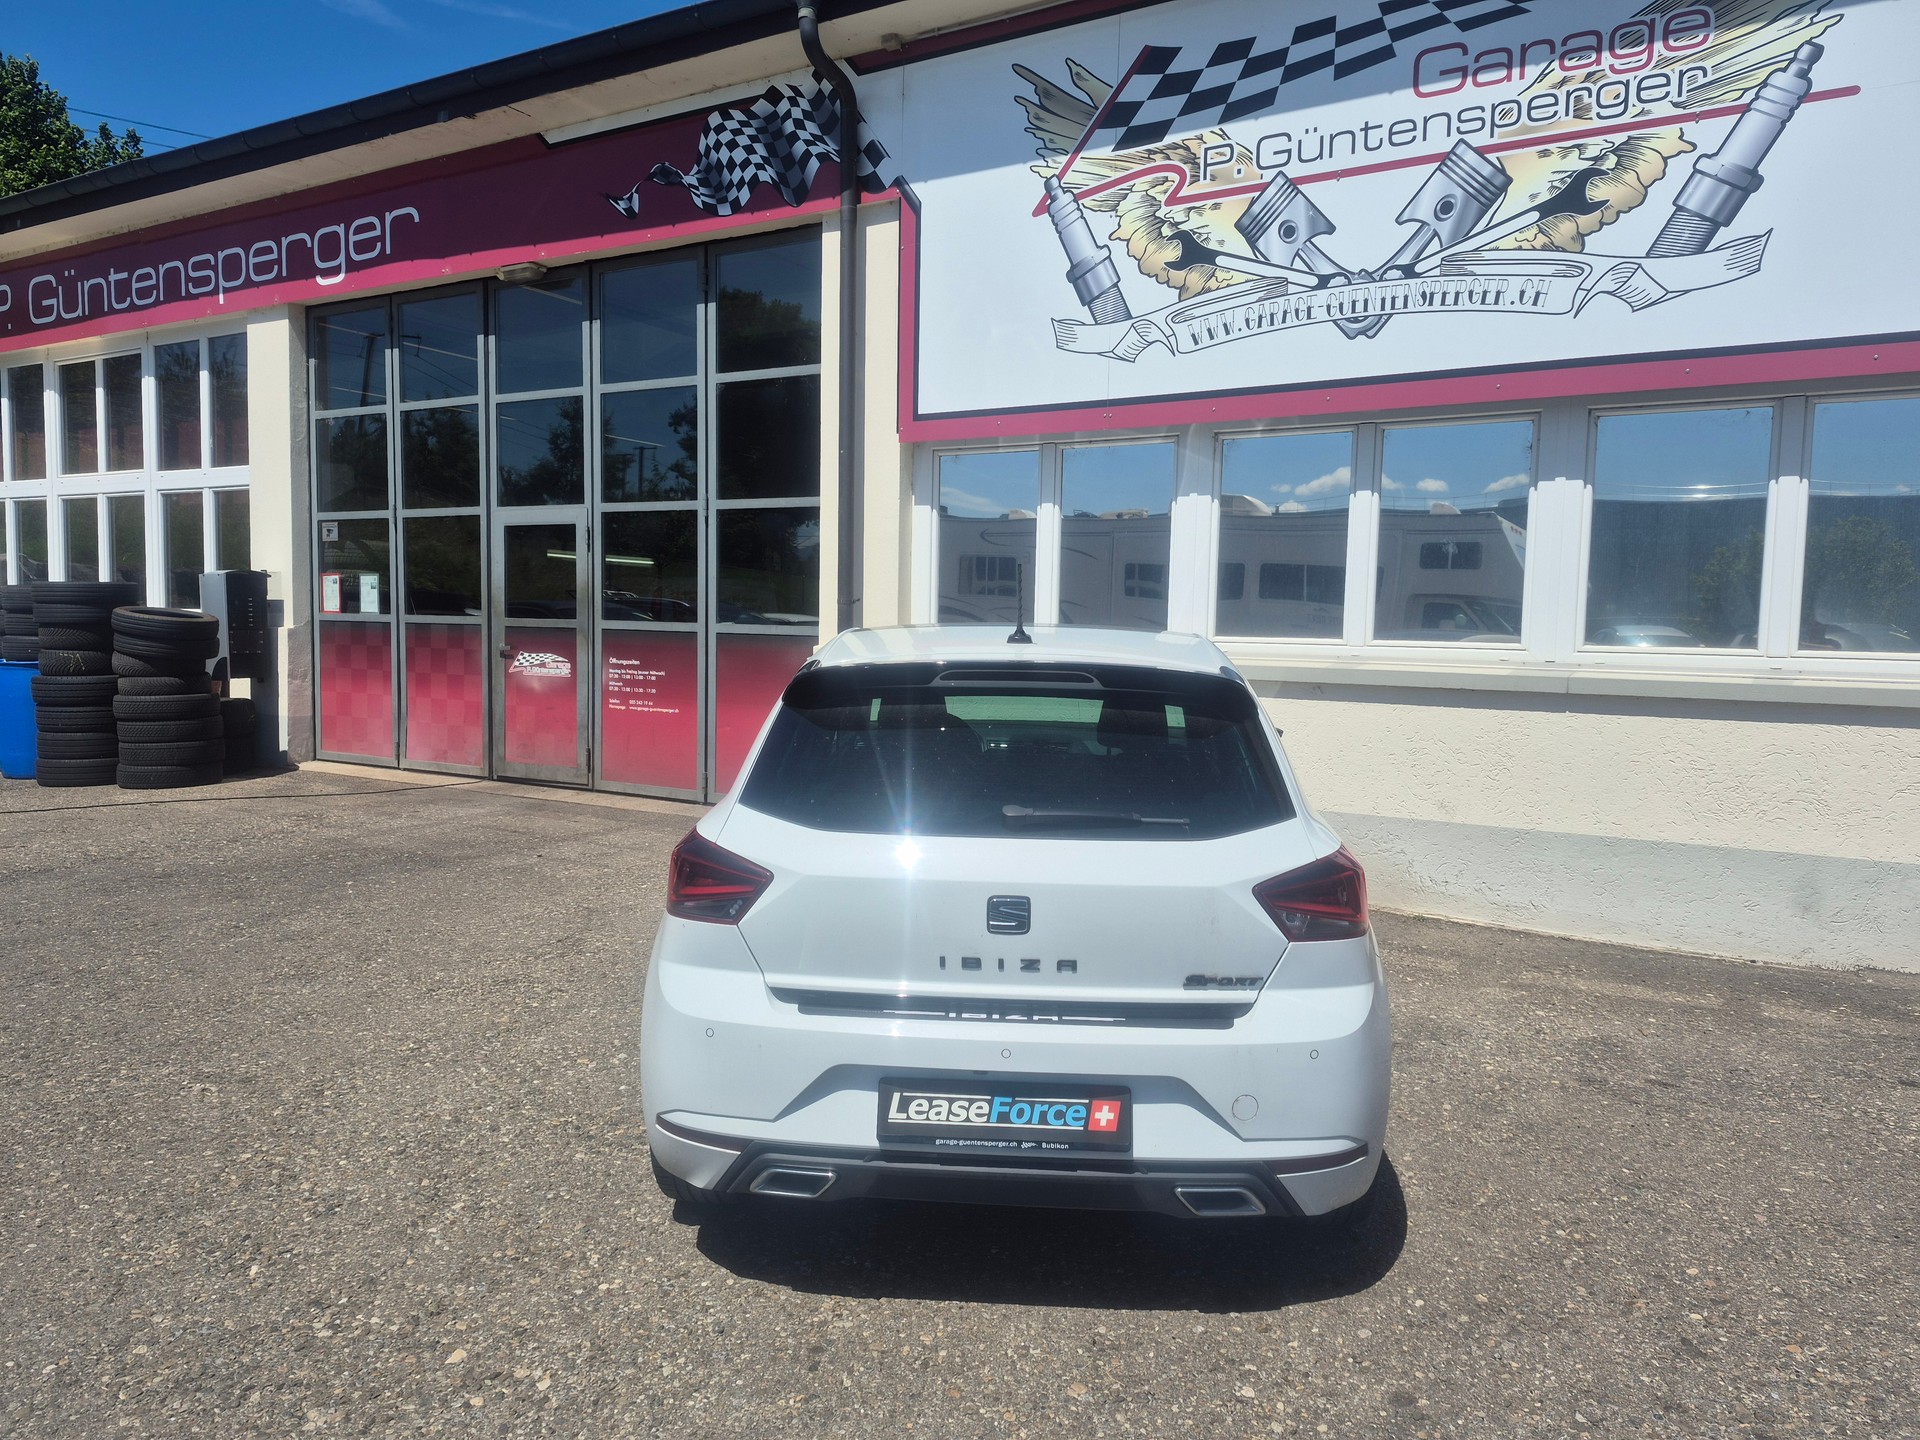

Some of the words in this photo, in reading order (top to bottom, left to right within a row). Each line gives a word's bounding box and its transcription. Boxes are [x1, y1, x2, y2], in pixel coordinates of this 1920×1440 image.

[1412, 8, 1712, 99] Garage
[1202, 154, 1243, 181] P.
[1255, 64, 1709, 171] Güntensperger
[28, 206, 420, 325] Güntensperger
[1187, 277, 1552, 346] WWW.GARAGE-GUENTENSPERGER.CH
[939, 955, 1078, 974] IBIZA
[888, 1092, 1087, 1127] LeaseForce
[935, 1138, 1018, 1148] garage-guentensperger.ch
